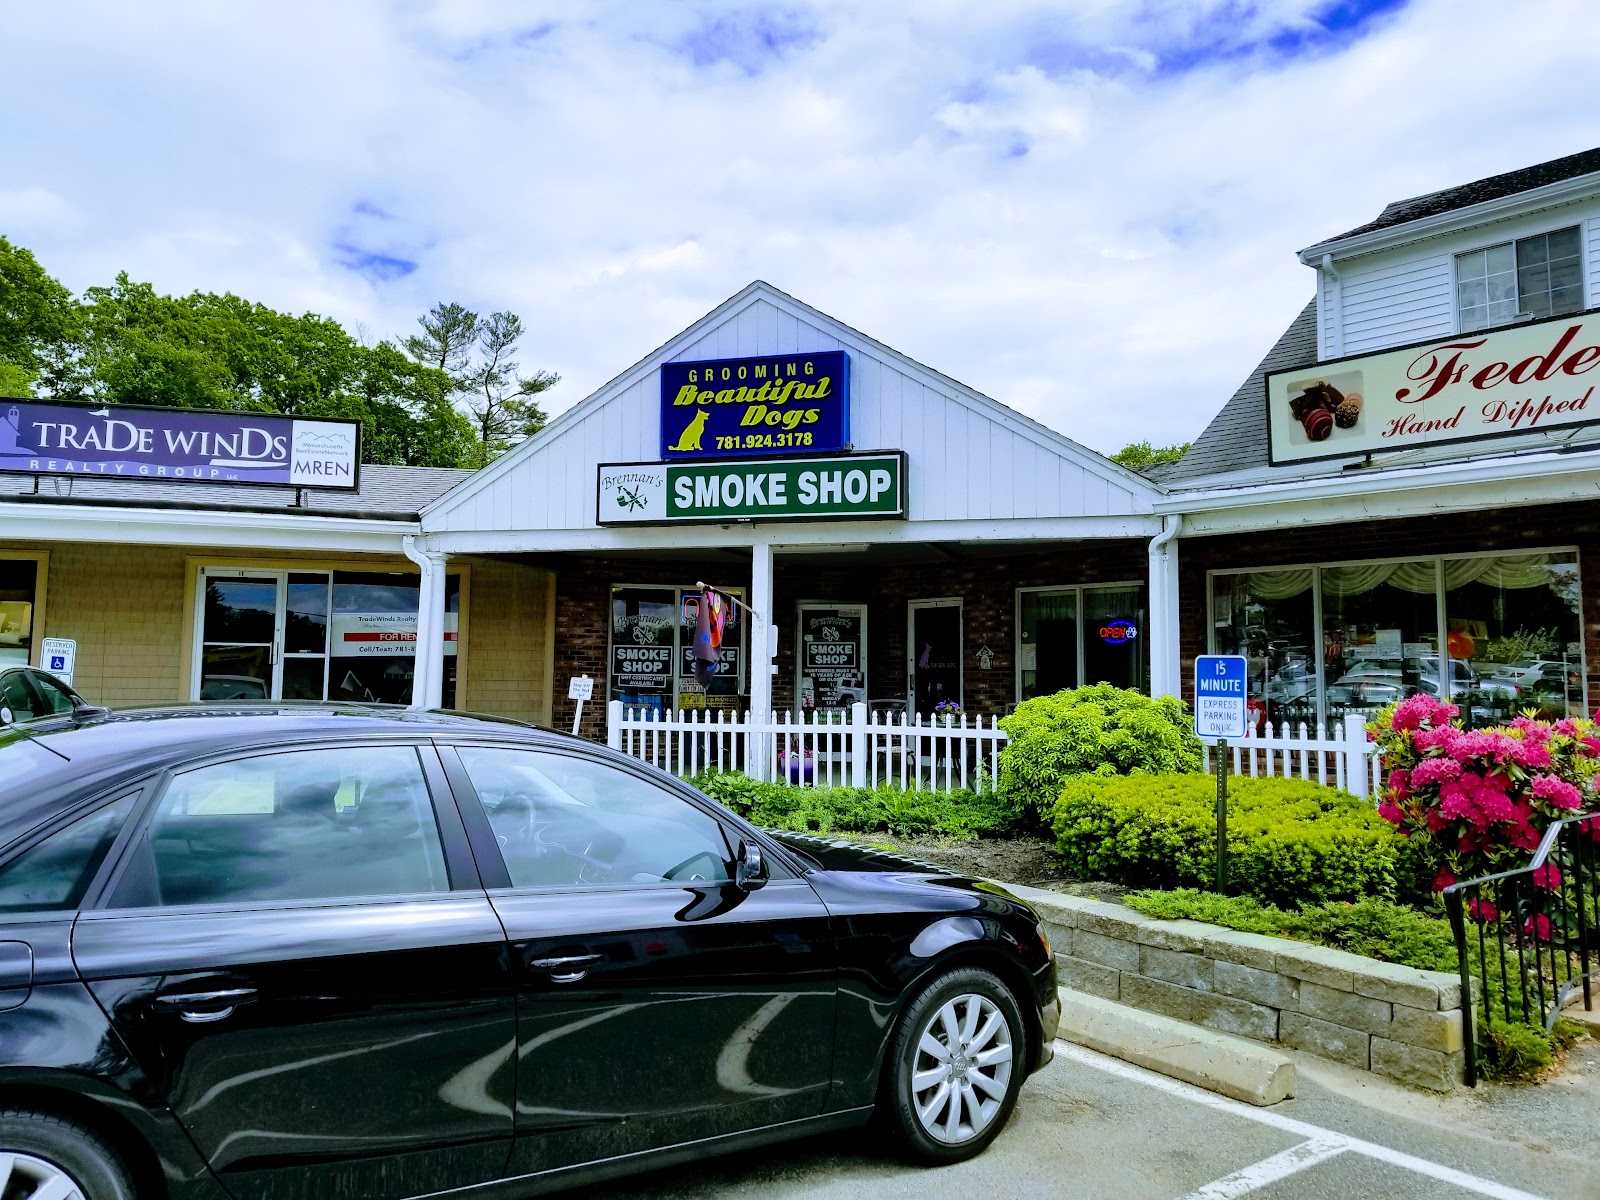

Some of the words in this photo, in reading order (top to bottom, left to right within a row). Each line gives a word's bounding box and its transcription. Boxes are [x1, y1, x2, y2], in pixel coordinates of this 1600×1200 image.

[1395, 324, 1600, 403] Fede
[689, 361, 814, 383] GROOMING
[673, 376, 831, 406] Beautiful
[740, 405, 821, 431] Dogs
[1382, 406, 1465, 438] Hand
[1482, 386, 1595, 428] Dipped
[716, 432, 813, 450] 781.924.3178
[30, 459, 124, 474] REALTY
[139, 465, 219, 479] GROUP
[294, 460, 349, 476] MREN
[602, 473, 663, 490] Brennan's
[674, 473, 787, 509] SMOKE
[798, 469, 891, 505] SHOP
[380, 633, 399, 641] FOR
[401, 633, 417, 641] REN
[1100, 627, 1126, 638] OPEN
[617, 649, 669, 660] SMOKE
[685, 650, 736, 661] SKE
[810, 645, 852, 654] SMOKE
[815, 655, 848, 664] SHOP
[623, 661, 662, 672] SHOP
[1215, 663, 1226, 675] 15
[1201, 679, 1241, 692] MINUTE
[1204, 700, 1237, 709] EXPRESS
[1204, 711, 1237, 720] PARKING
[1210, 723, 1232, 732] ONLY
